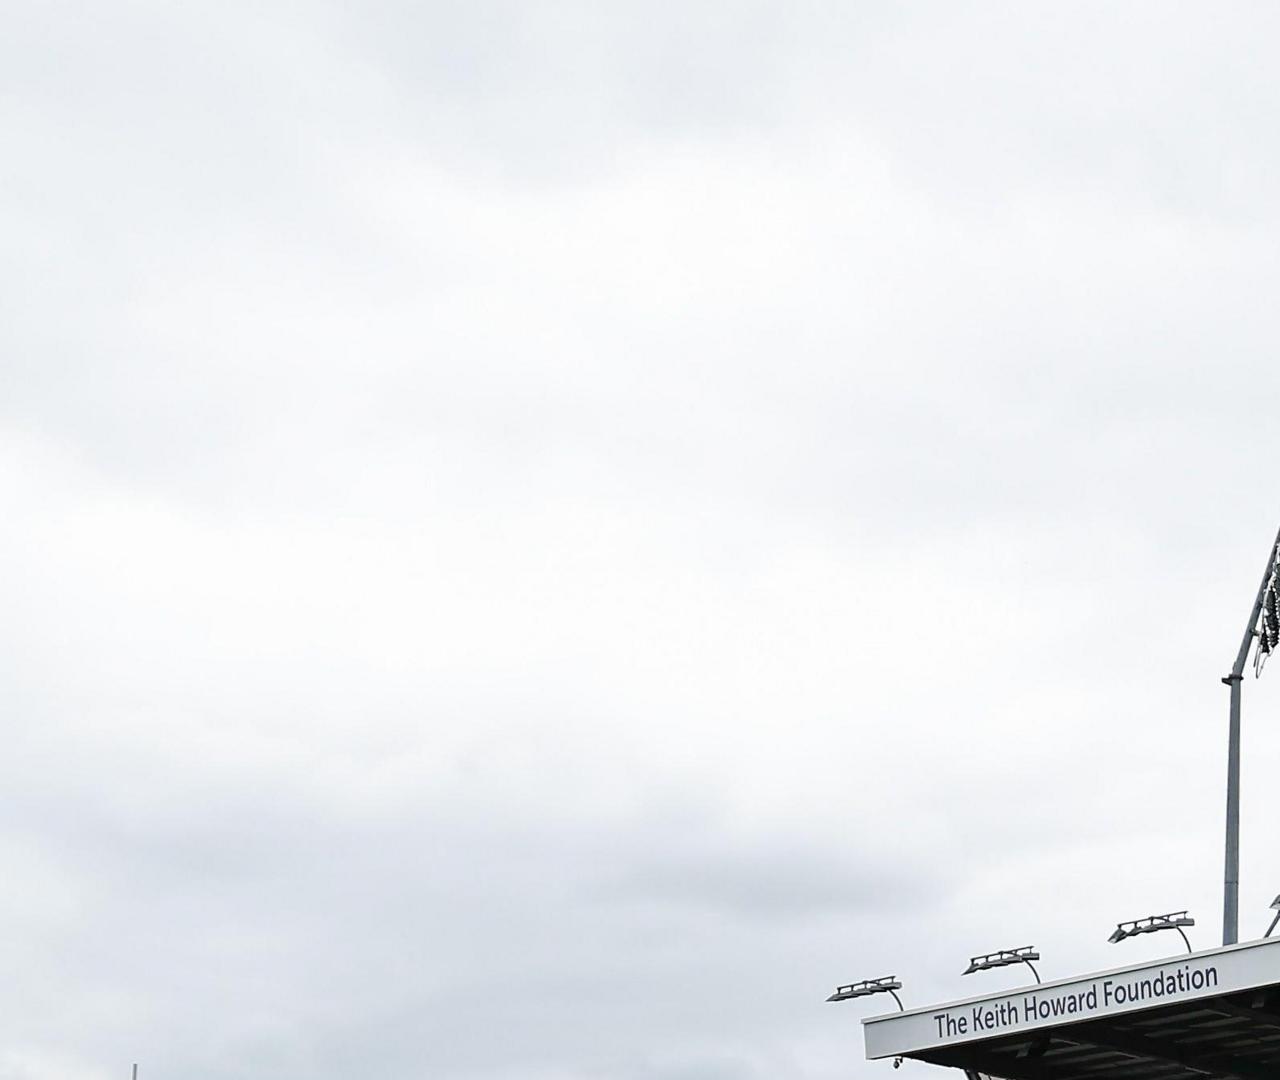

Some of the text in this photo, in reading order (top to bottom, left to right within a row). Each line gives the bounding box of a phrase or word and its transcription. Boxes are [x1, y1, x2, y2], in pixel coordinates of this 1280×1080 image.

[934, 966, 1218, 1038] The Keith Howard Foundation
